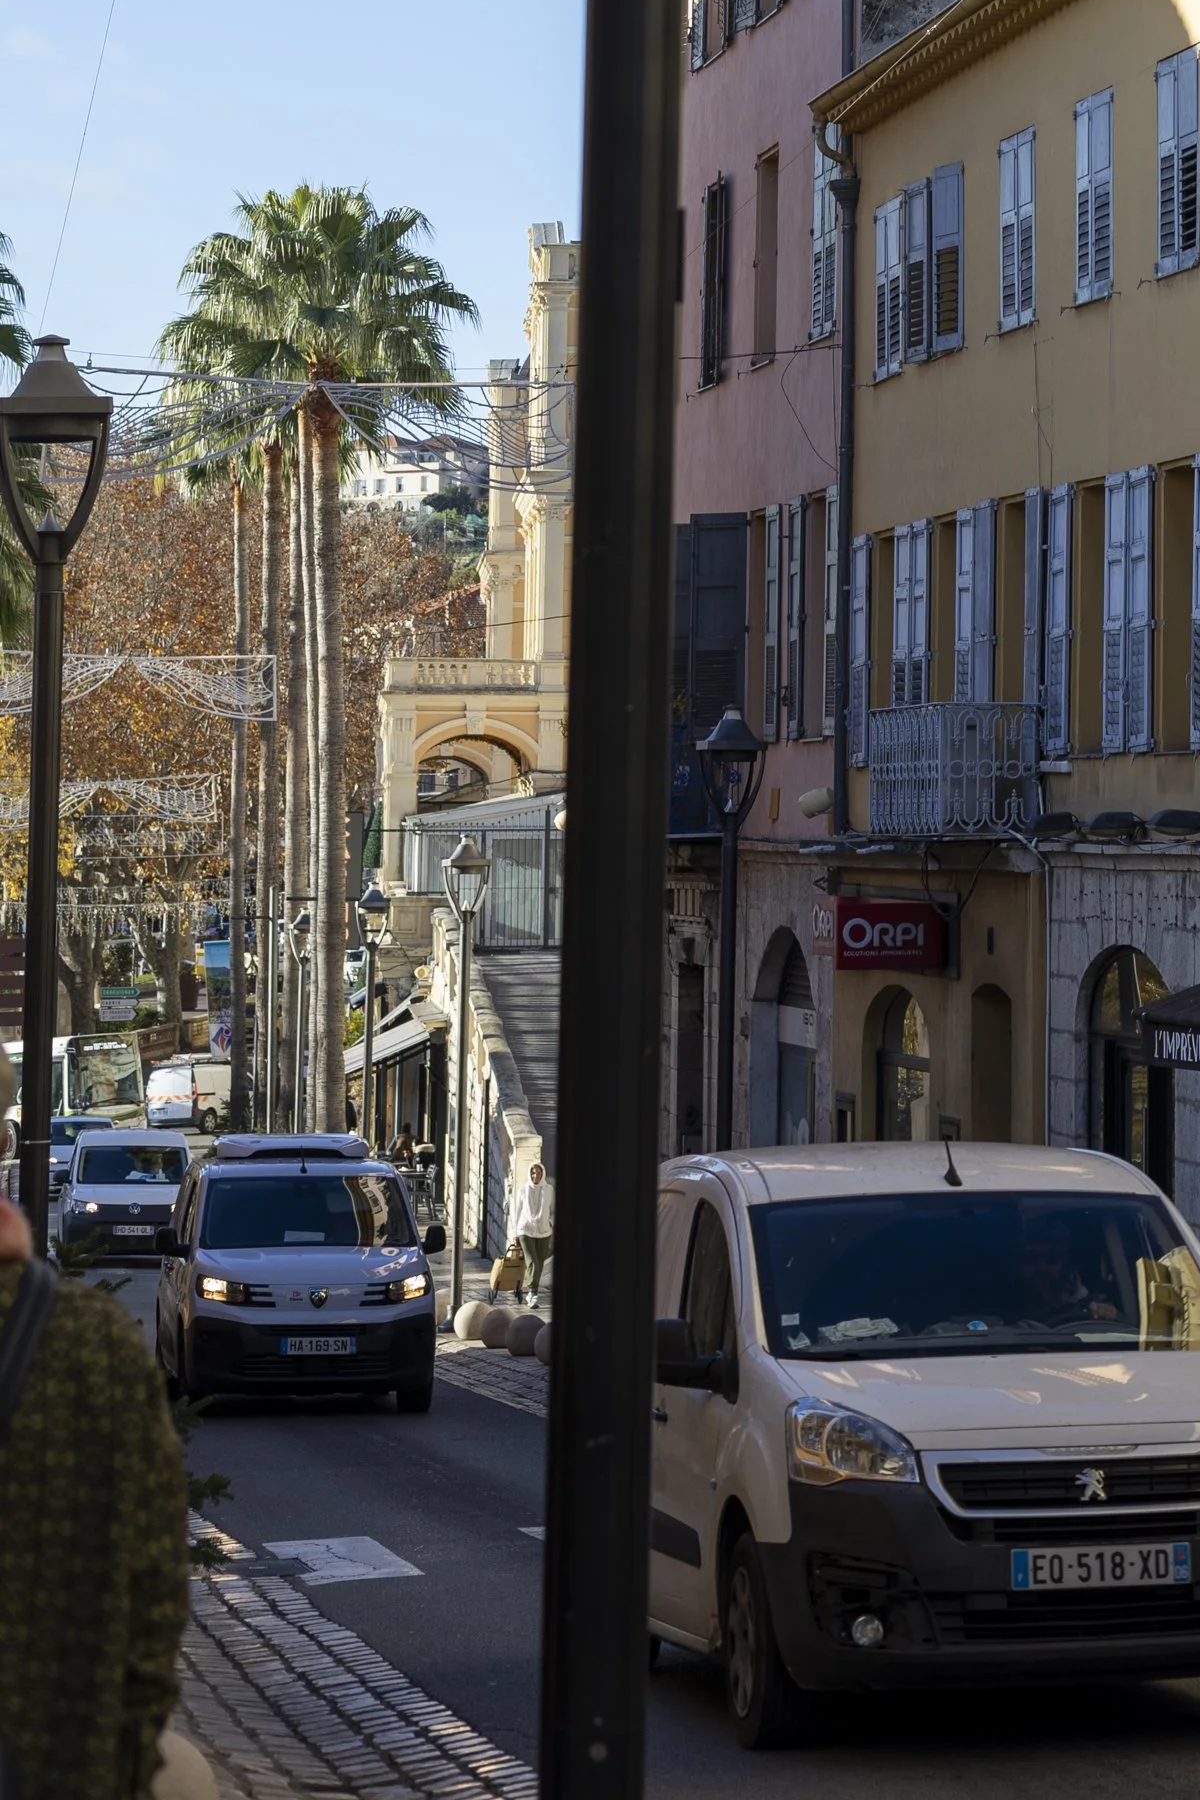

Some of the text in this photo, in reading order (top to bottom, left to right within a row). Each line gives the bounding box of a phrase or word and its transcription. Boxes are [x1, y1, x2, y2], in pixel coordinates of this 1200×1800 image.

[842, 917, 924, 949] ORPI
[843, 949, 879, 957] SOLUTIONS
[289, 1339, 348, 1352] HA-169-SN
